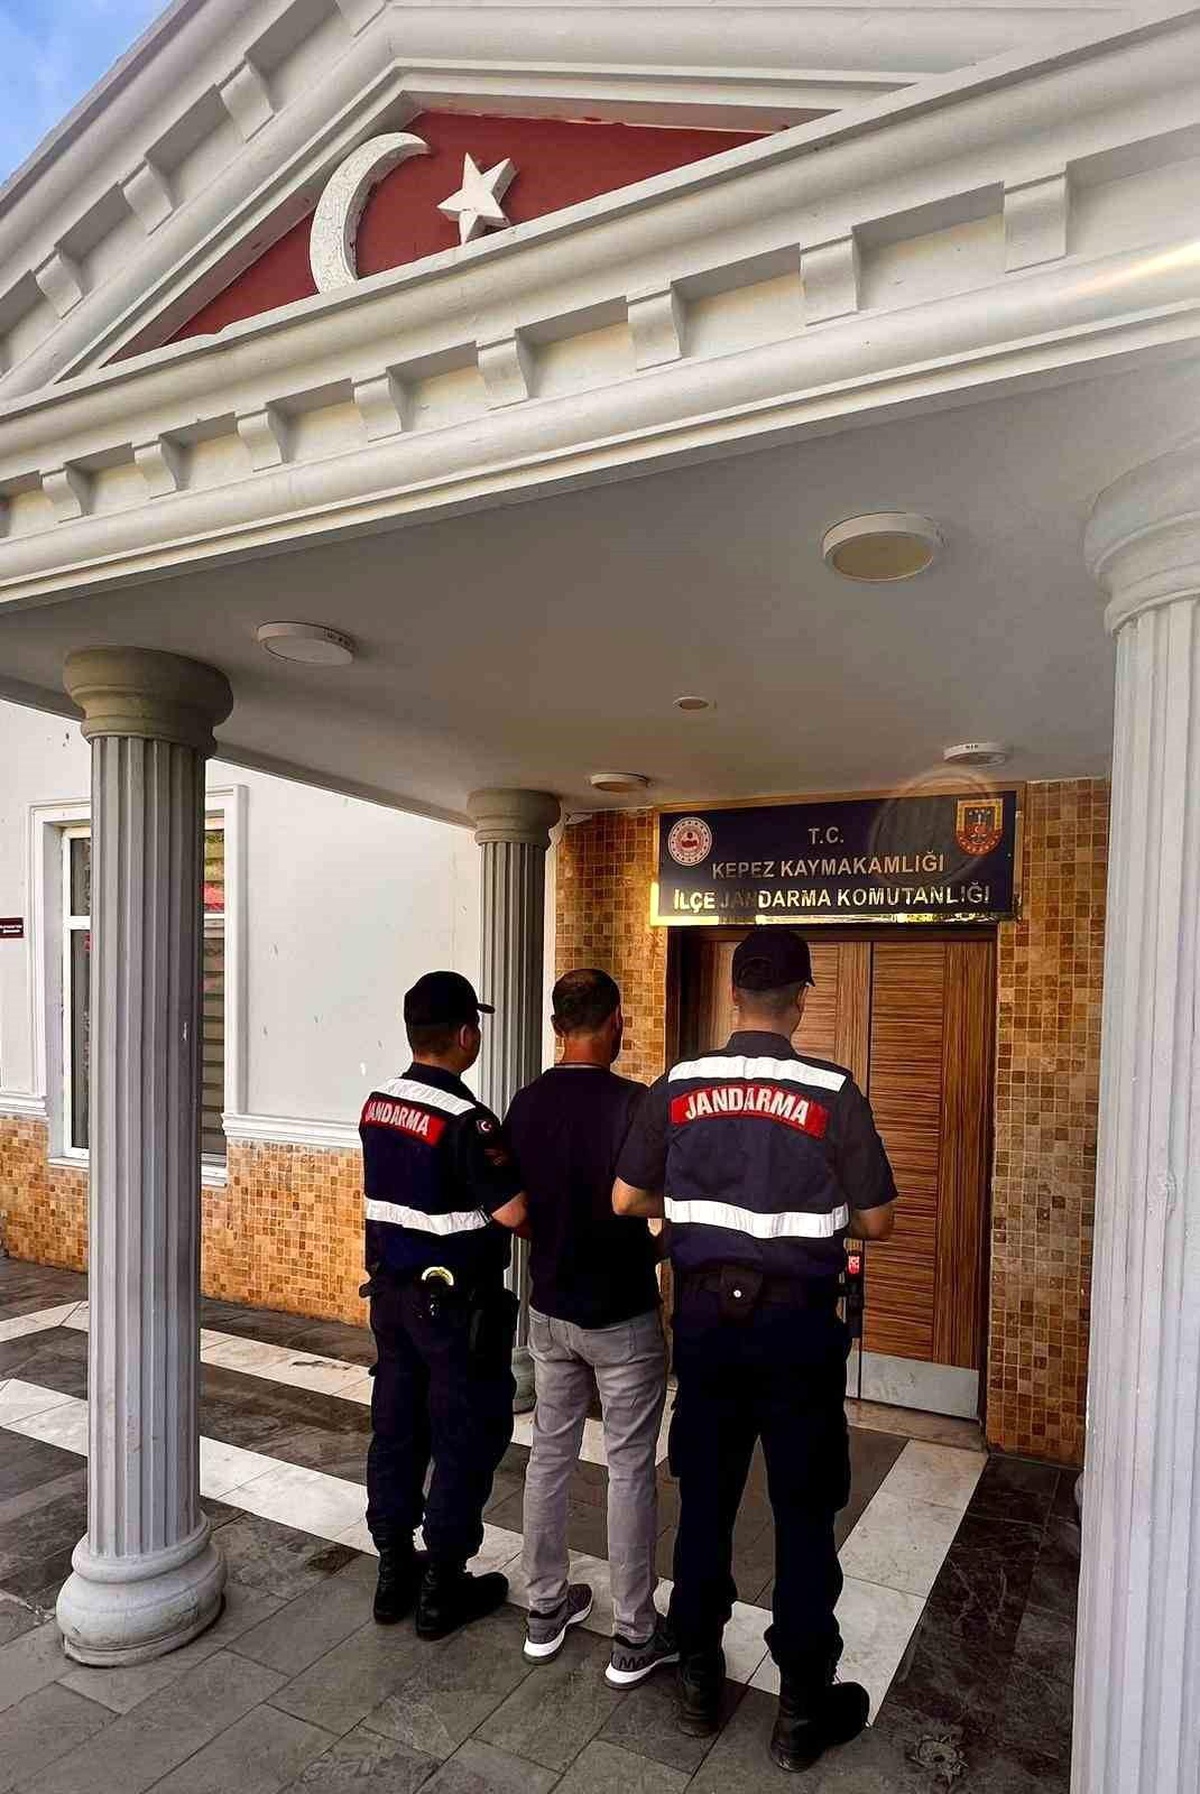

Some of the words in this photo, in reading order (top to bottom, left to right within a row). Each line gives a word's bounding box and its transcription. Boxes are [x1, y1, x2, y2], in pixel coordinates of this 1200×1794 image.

[808, 826, 845, 845] T.C.
[712, 861, 775, 880] KEPEZ
[780, 850, 944, 878] KAYMAKAMLIĞI
[673, 888, 716, 914] İLÇE
[836, 880, 990, 907] KOMUTANLIĞI
[365, 1101, 431, 1137] JANDARMA
[685, 1086, 810, 1126] JANDARMA
